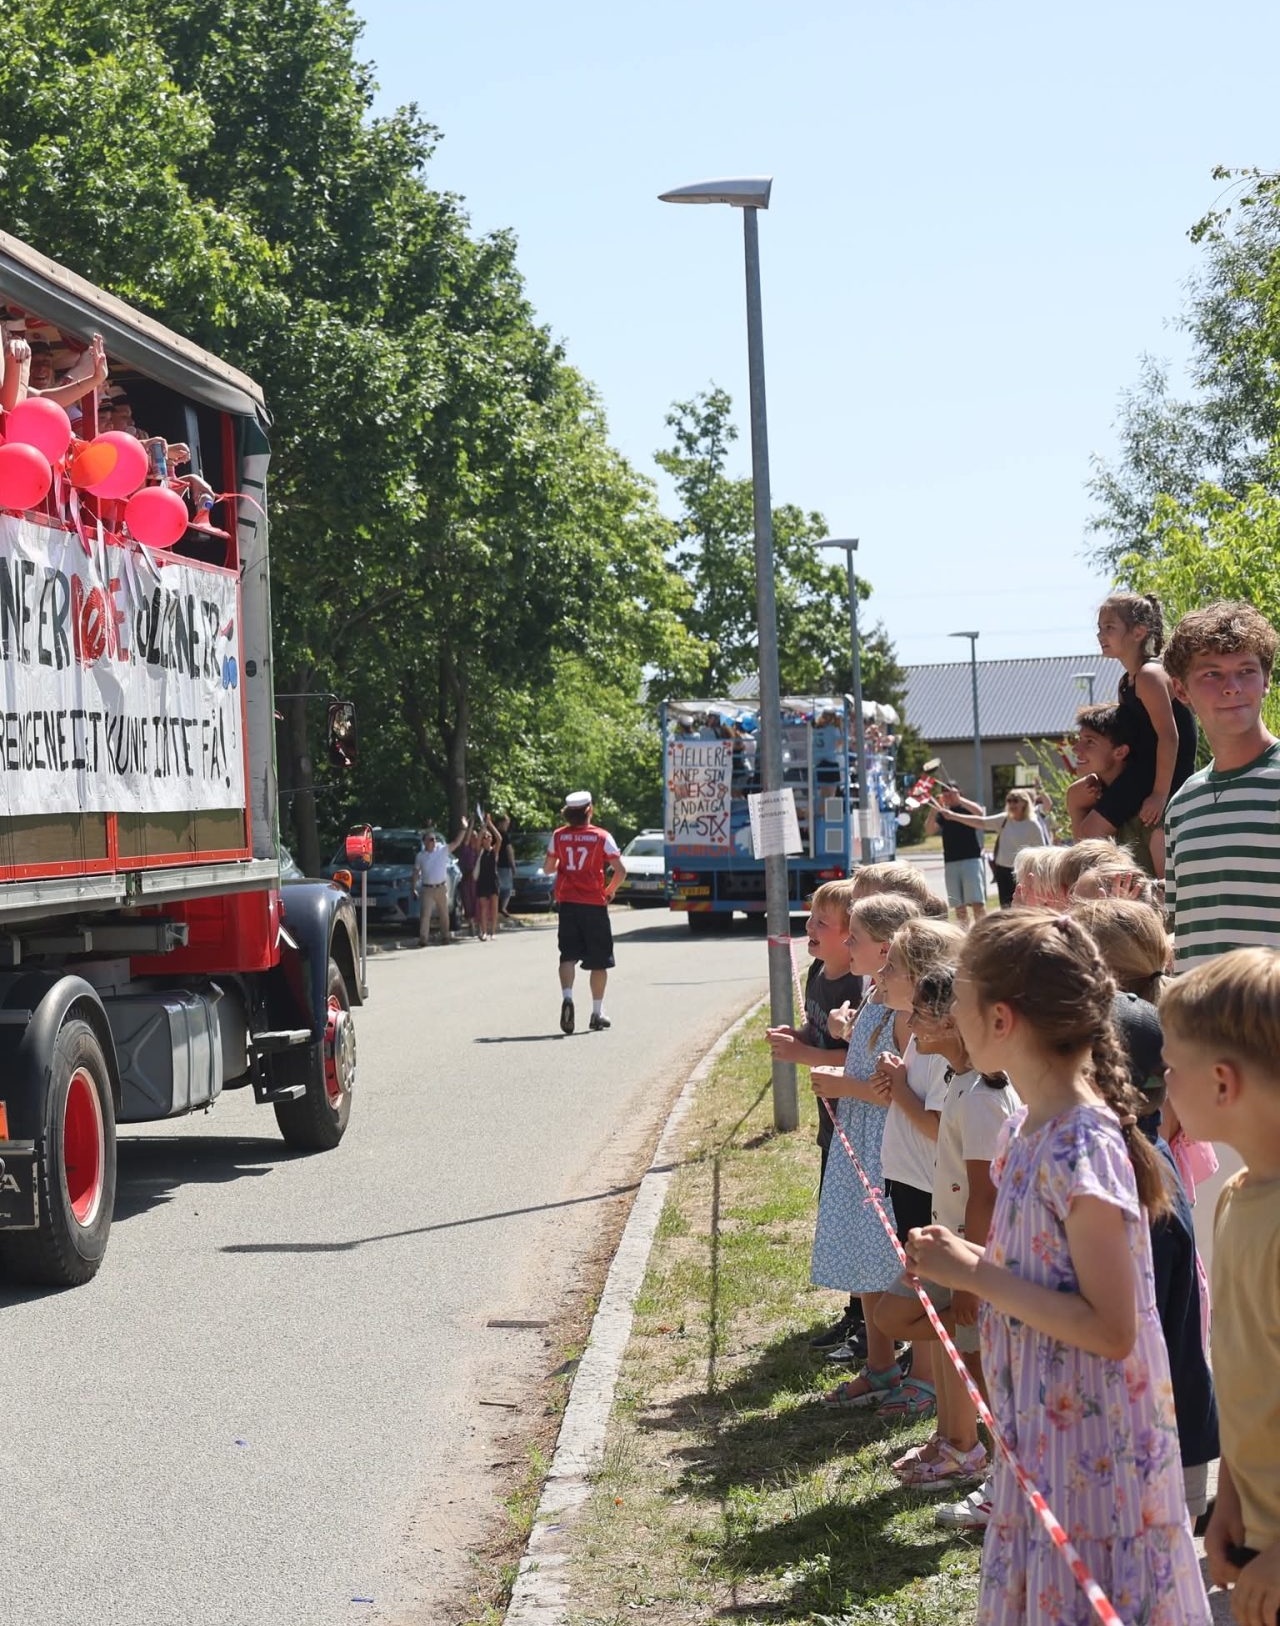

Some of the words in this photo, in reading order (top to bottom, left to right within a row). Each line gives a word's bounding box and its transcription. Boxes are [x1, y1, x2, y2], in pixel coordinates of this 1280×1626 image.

[38, 566, 71, 671] ER
[672, 746, 728, 768] HELLERE
[565, 846, 589, 871] 17
